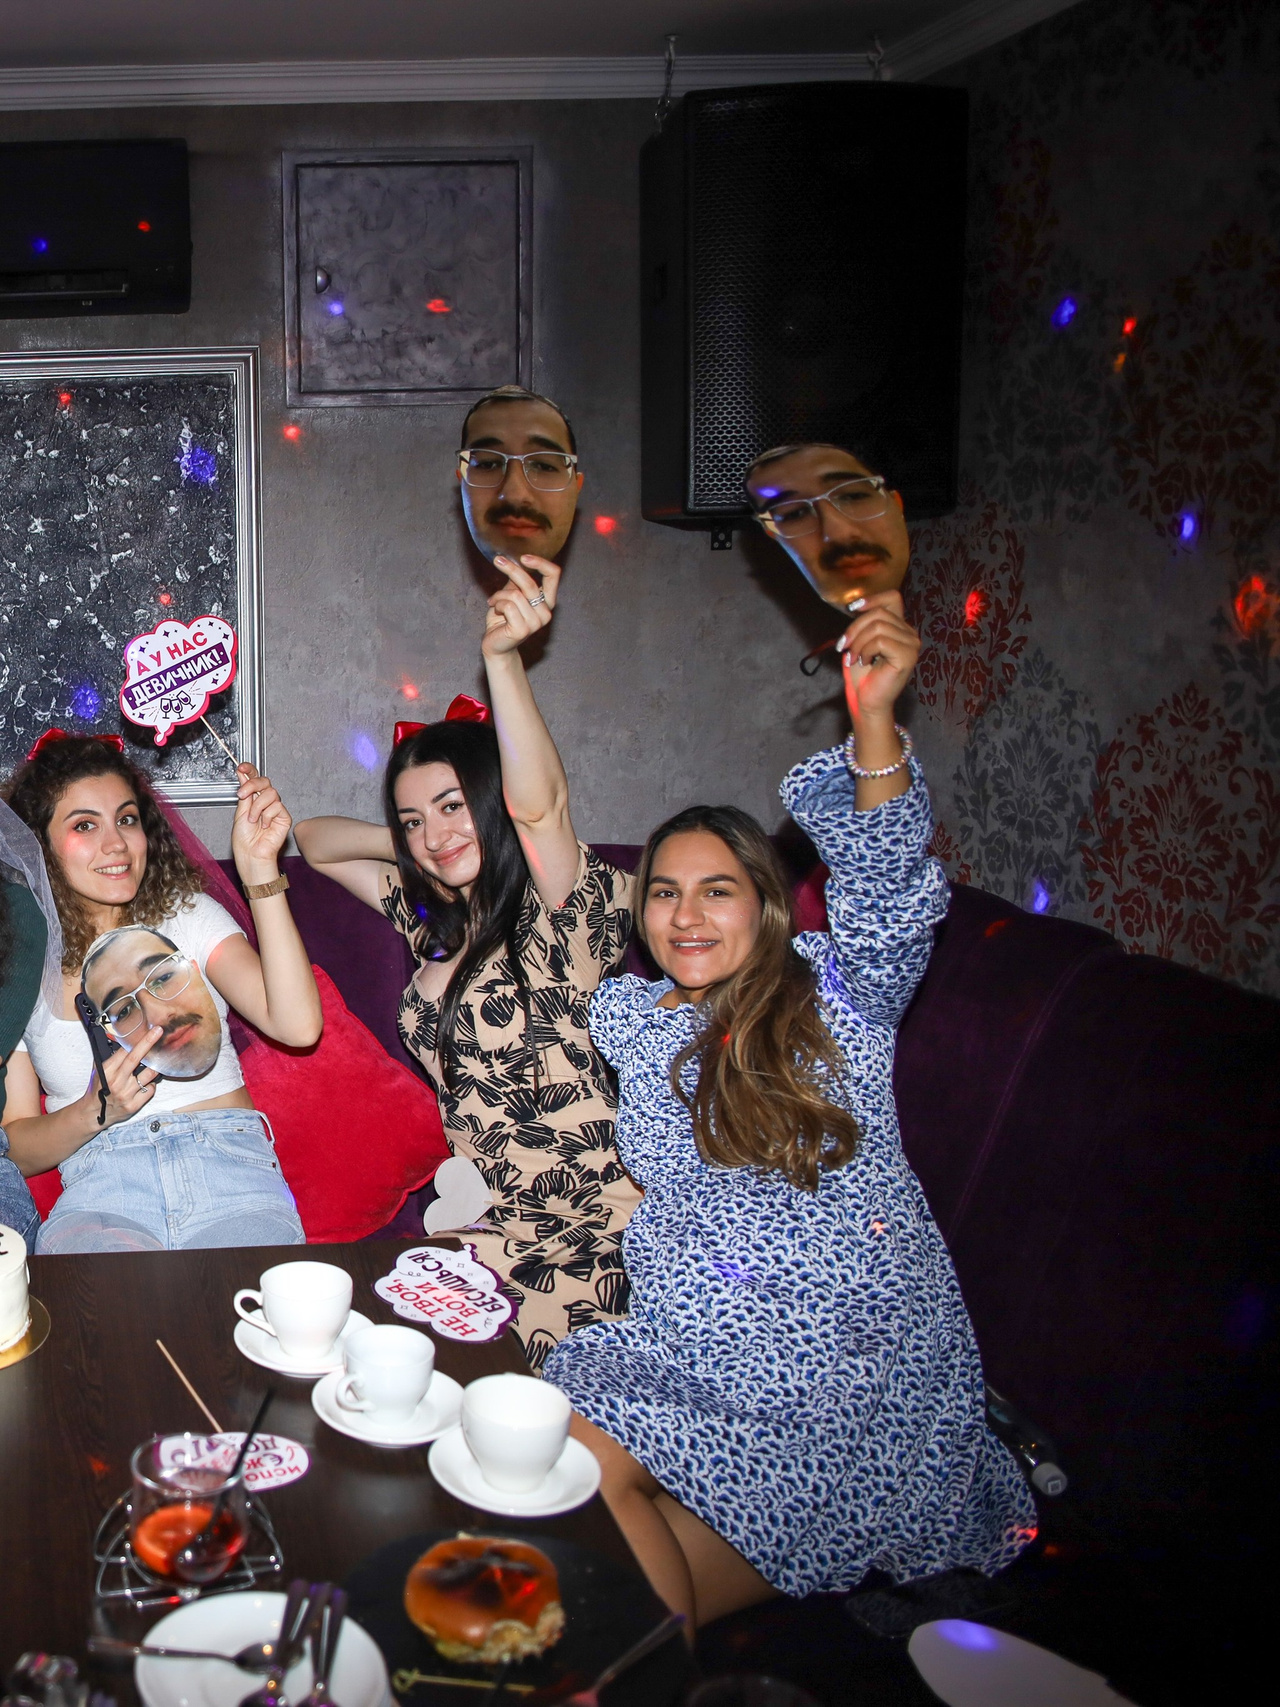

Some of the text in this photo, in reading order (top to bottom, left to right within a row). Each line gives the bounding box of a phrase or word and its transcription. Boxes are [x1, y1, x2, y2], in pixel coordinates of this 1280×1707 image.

[130, 648, 223, 707] ДЕВИЧНИК!
[136, 631, 208, 677] А У НАС
[386, 1278, 479, 1338] НЕ ТВОЯ,
[406, 1251, 506, 1314] БЕСИШЬСЯ!
[414, 1281, 481, 1319] ВОТ И
